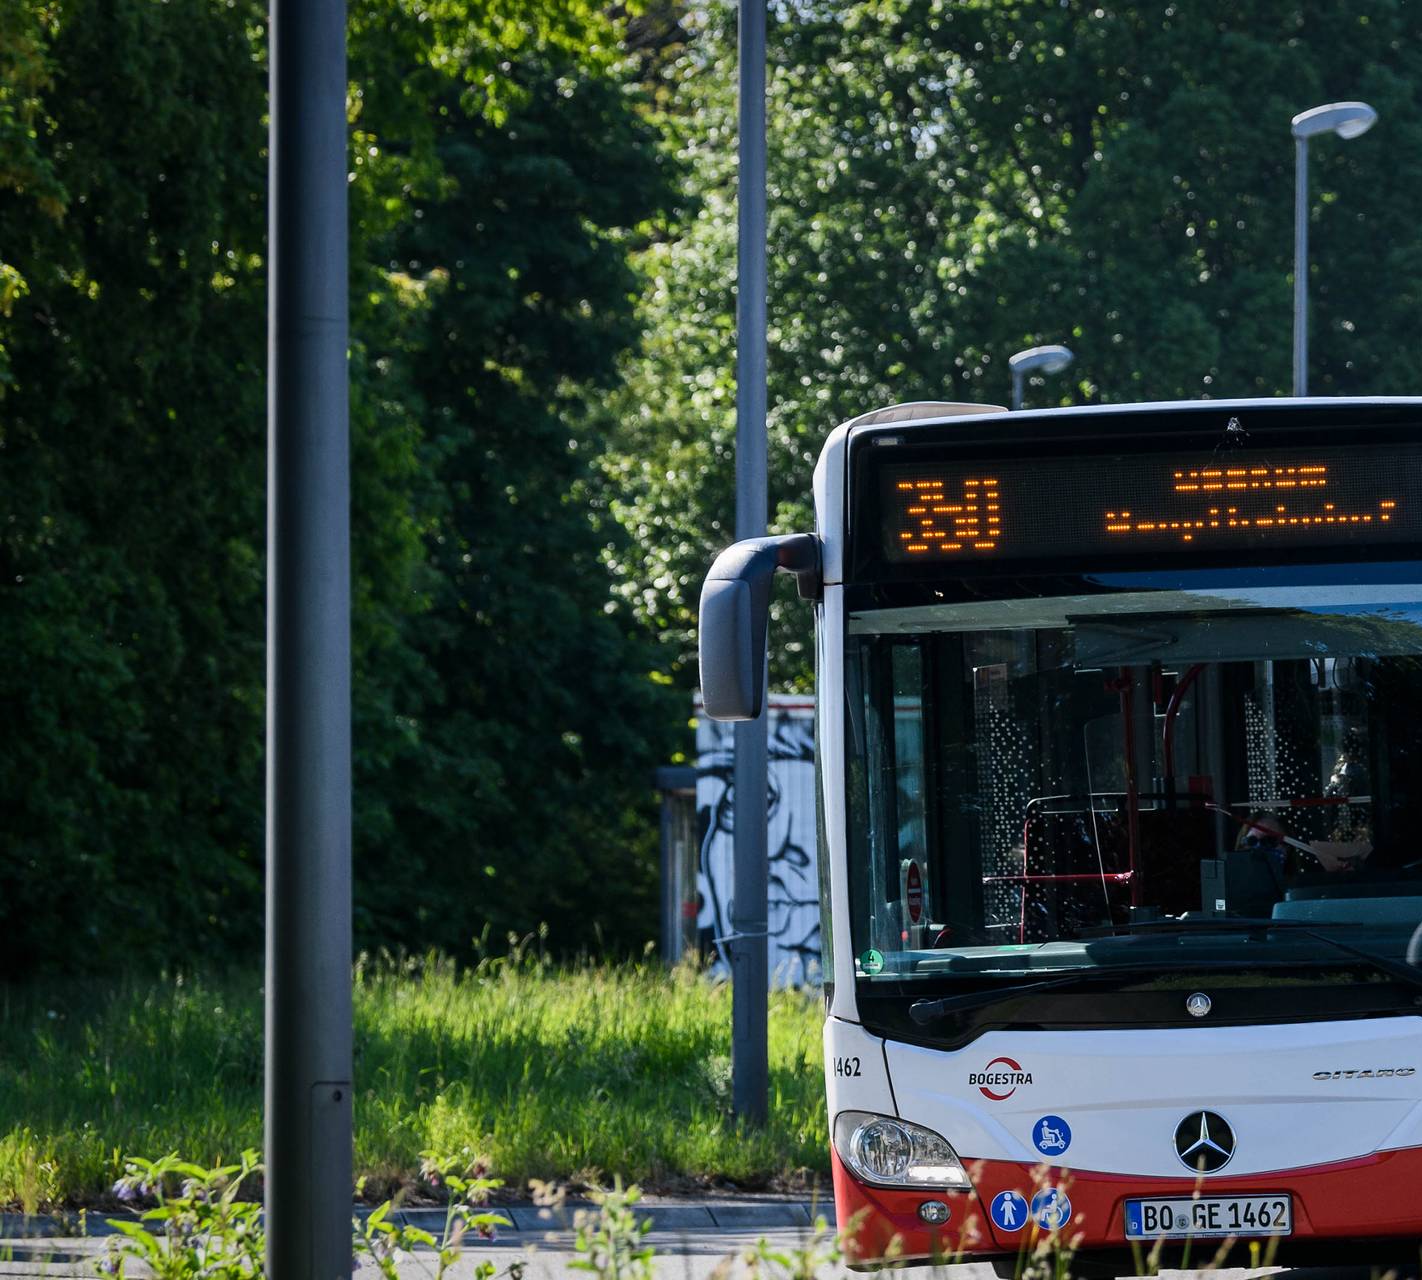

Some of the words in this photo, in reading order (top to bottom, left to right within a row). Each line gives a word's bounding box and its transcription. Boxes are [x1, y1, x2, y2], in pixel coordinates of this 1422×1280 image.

[968, 1073, 1033, 1085] BOGESTRA
[1312, 1068, 1416, 1081] CITARO
[1143, 1204, 1173, 1231] BO
[1192, 1203, 1222, 1230] GE
[1228, 1201, 1287, 1229] 1462
